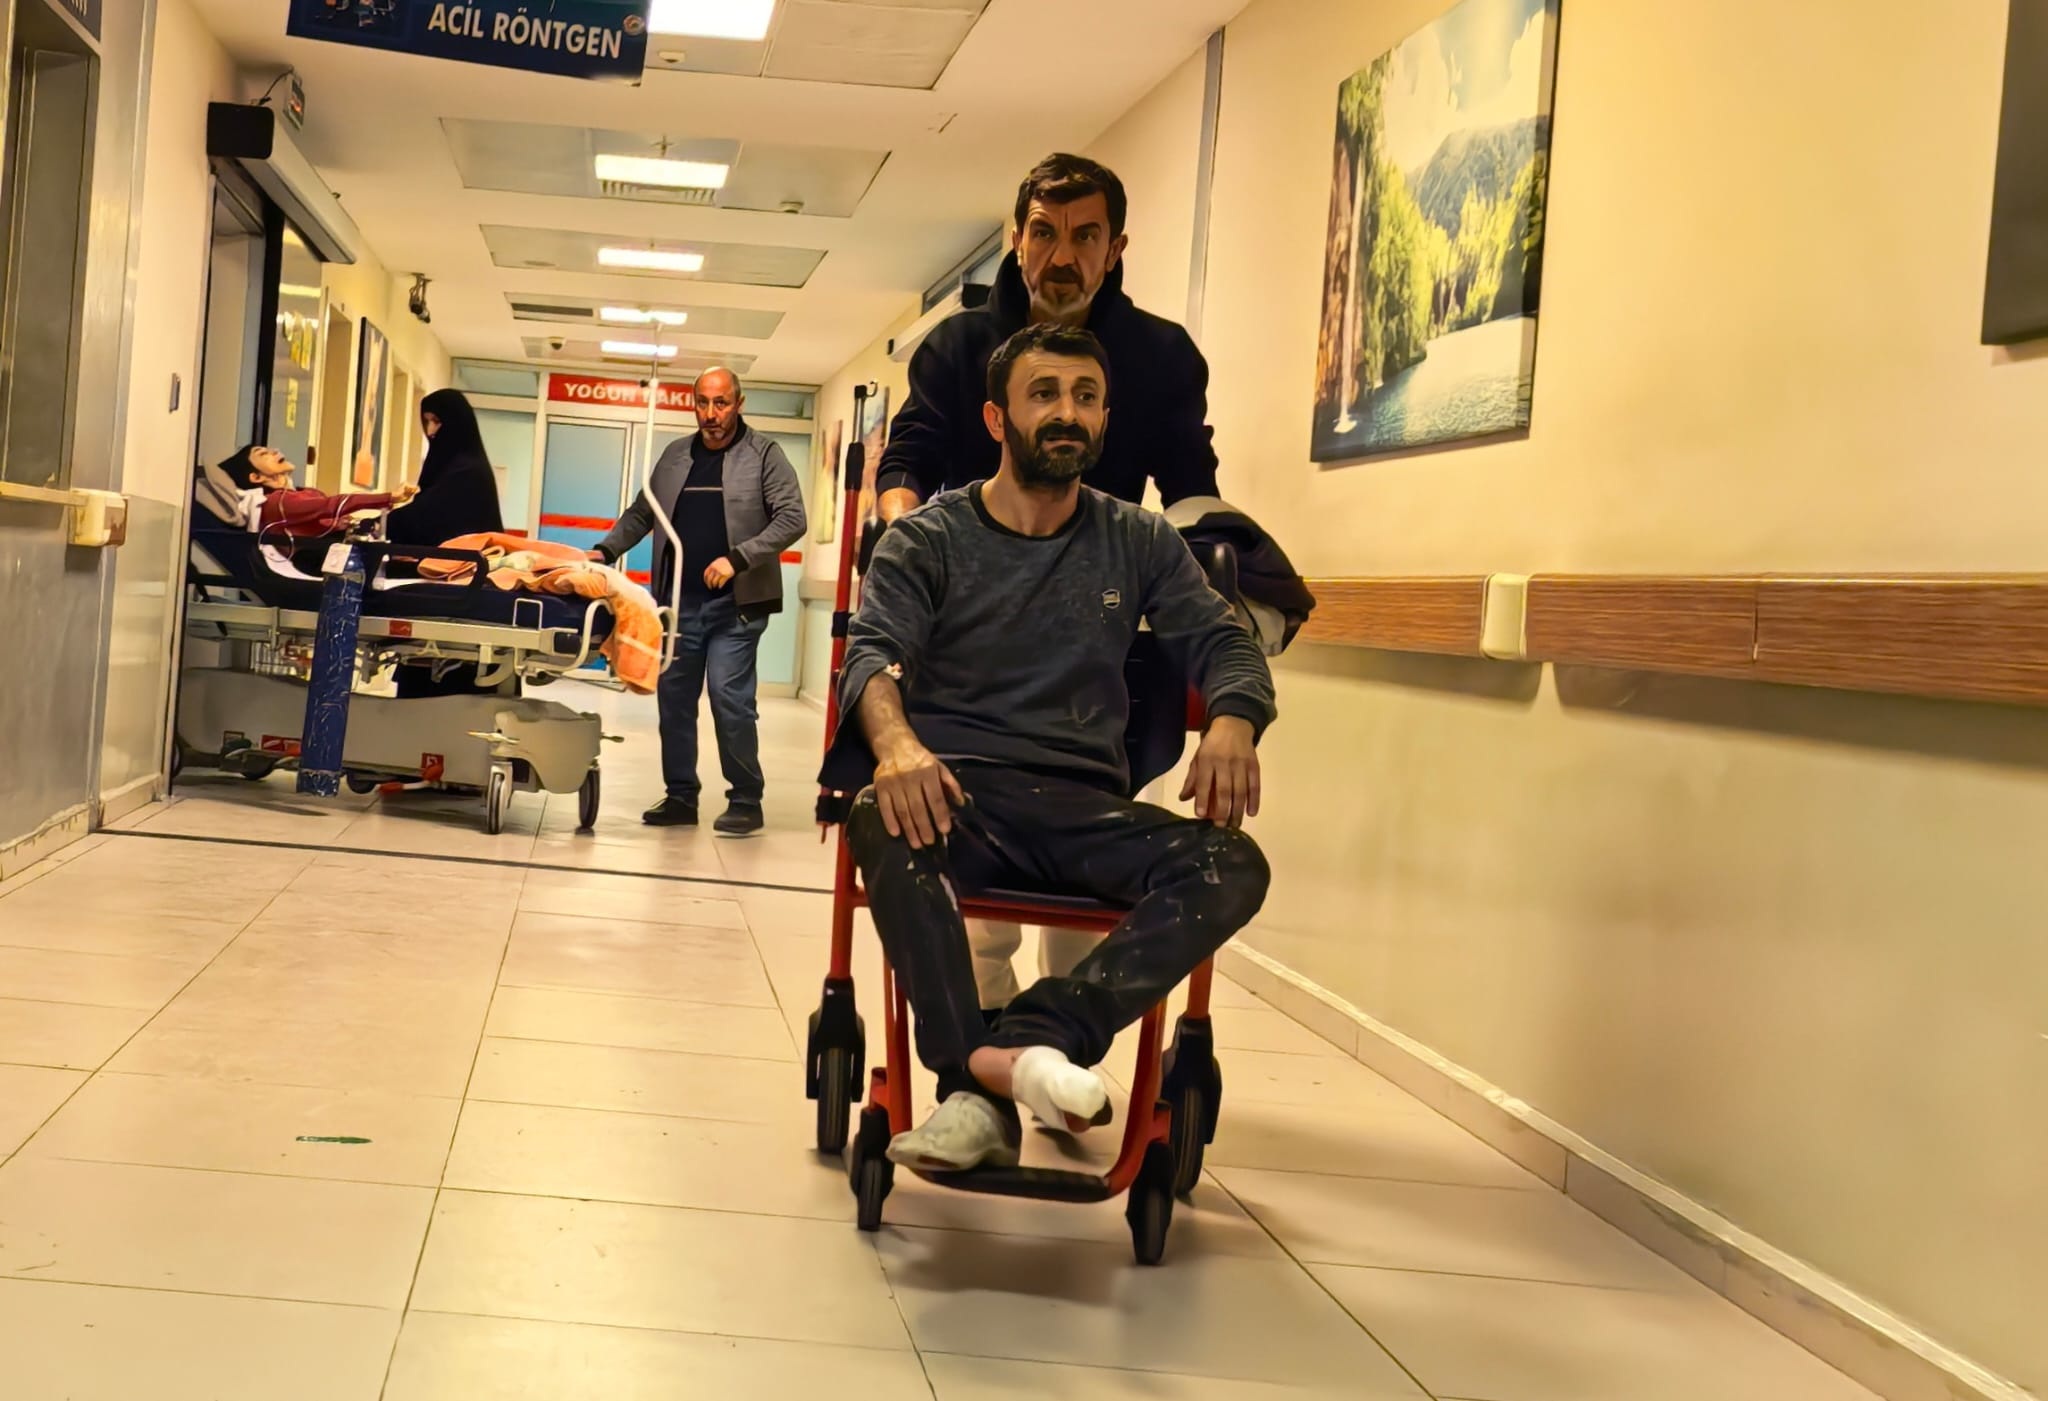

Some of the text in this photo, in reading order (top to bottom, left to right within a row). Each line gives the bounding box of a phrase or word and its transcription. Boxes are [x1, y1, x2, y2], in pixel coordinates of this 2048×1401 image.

[428, 0, 623, 59] ACİL RÖNTGEN
[642, 387, 696, 408] AKI
